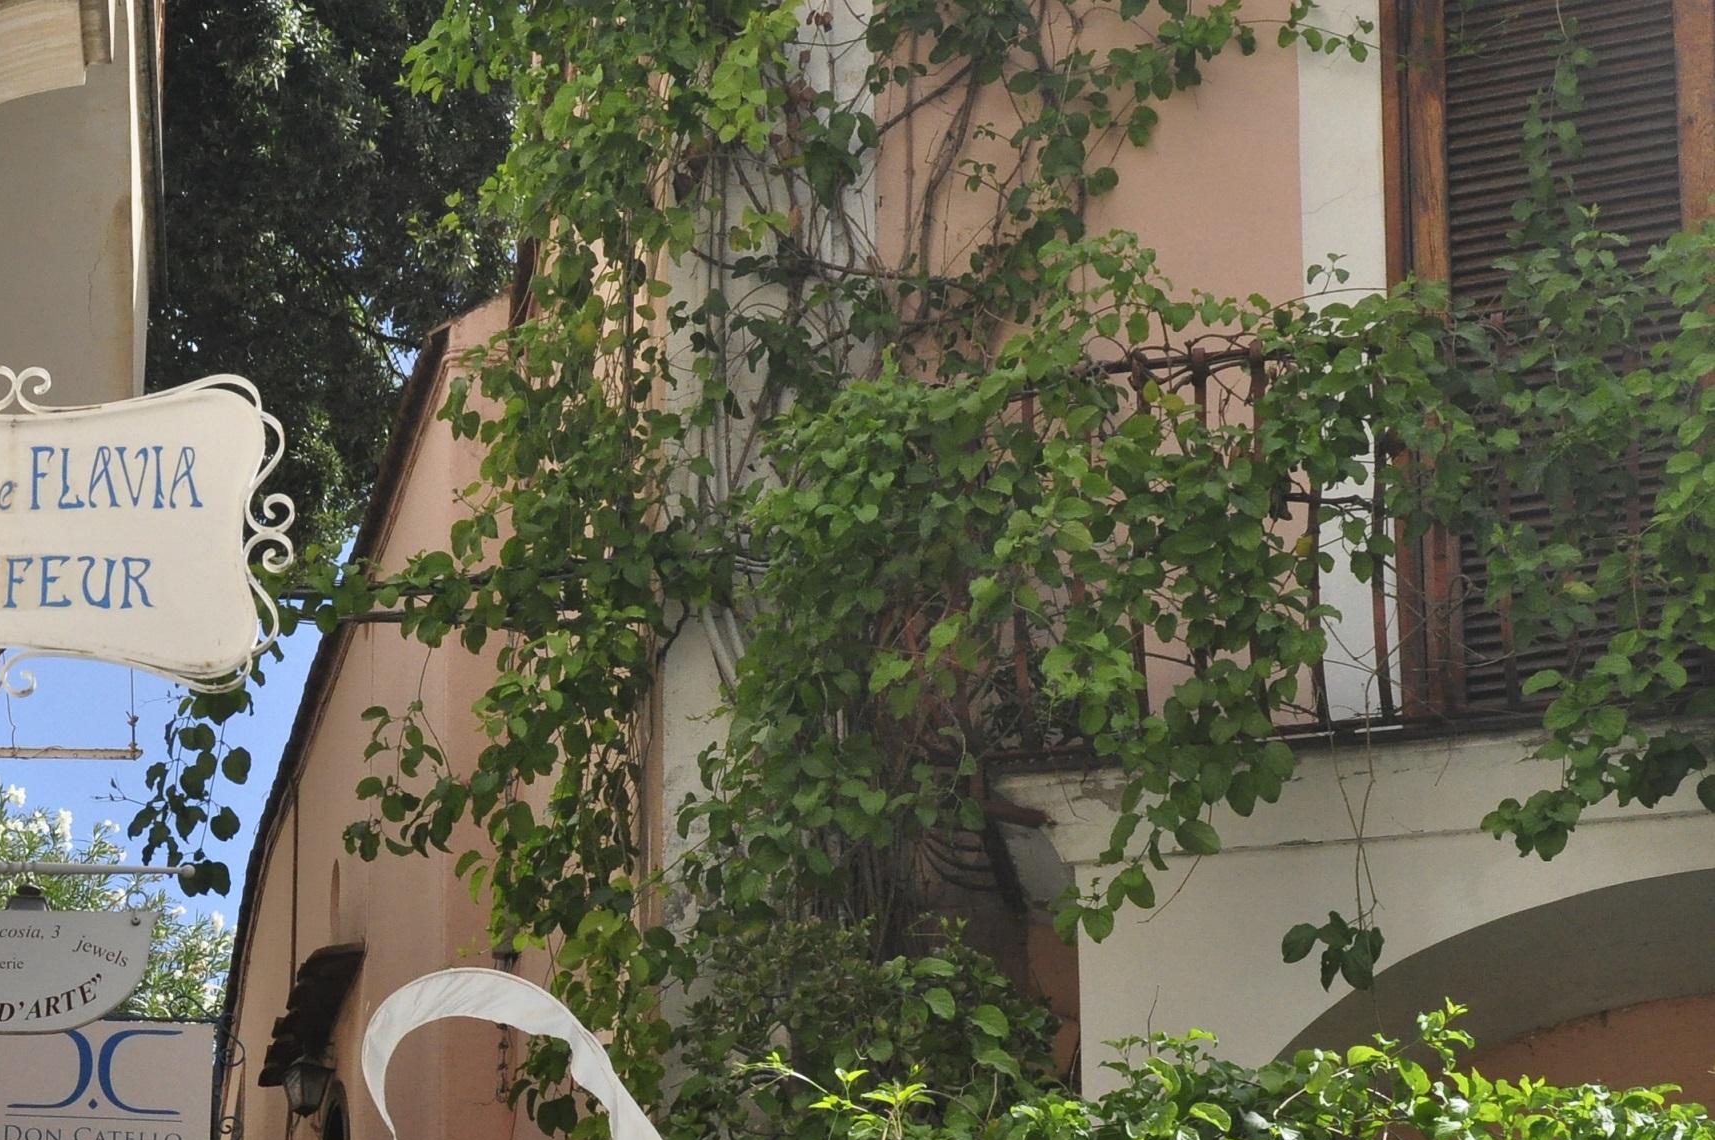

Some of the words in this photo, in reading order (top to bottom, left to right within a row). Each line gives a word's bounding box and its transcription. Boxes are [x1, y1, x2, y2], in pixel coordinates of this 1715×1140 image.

[30, 445, 204, 512] FLAVIA
[51, 924, 61, 939] 3
[72, 935, 130, 968] jewels
